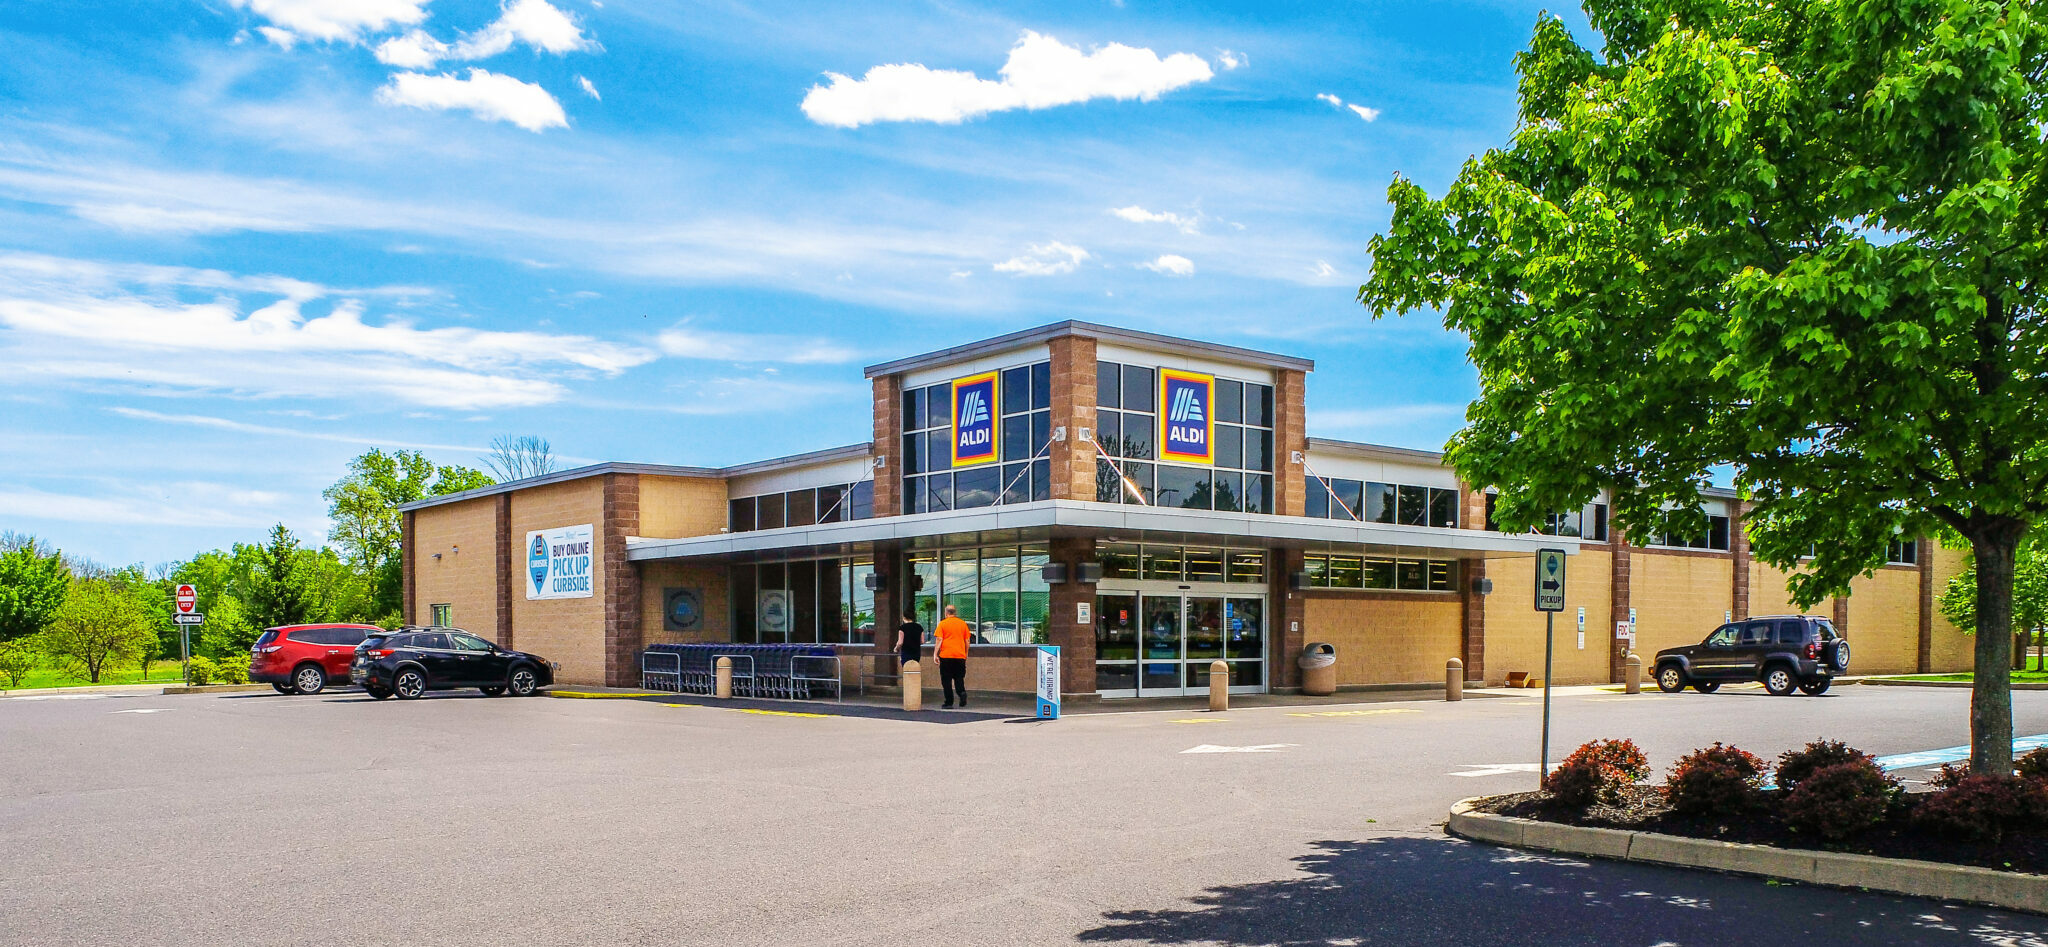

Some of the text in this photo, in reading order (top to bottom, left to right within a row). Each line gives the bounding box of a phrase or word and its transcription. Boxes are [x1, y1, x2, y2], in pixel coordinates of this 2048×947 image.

[960, 428, 989, 447] ALDI
[1170, 425, 1204, 444] ALDI
[553, 544, 565, 557] BUY
[566, 541, 589, 556] ONLINE
[552, 556, 589, 576] PICK UP
[552, 576, 589, 592] CURBSIDE
[1541, 595, 1562, 603] PICKUP
[1618, 625, 1628, 636] FDC
